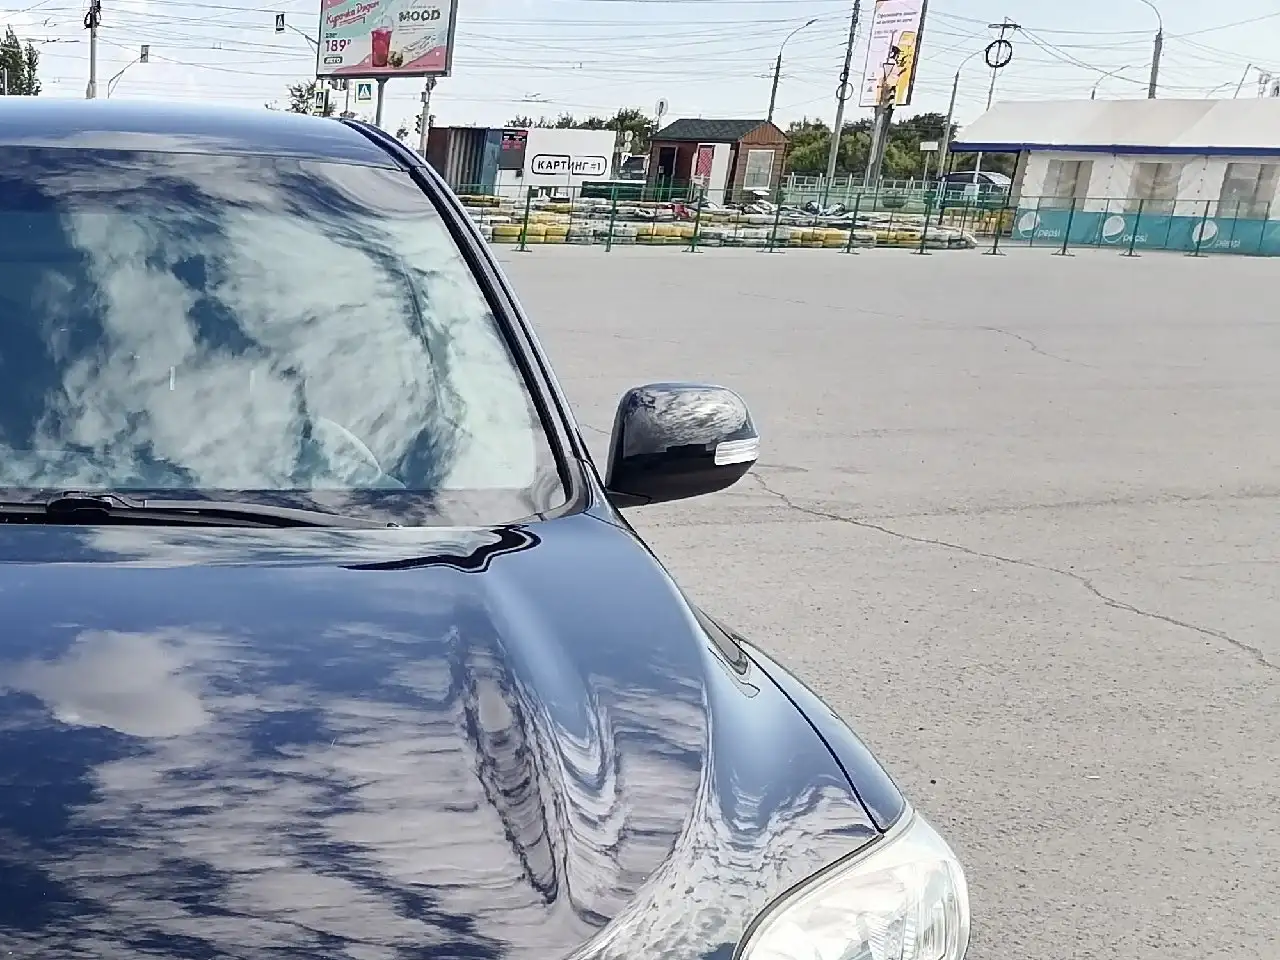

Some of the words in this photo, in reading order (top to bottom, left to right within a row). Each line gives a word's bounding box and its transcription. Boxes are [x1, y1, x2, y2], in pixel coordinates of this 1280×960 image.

[398, 9, 441, 22] MOOD
[537, 160, 589, 171] КАРТИНГ
[1037, 228, 1061, 240] pepsi
